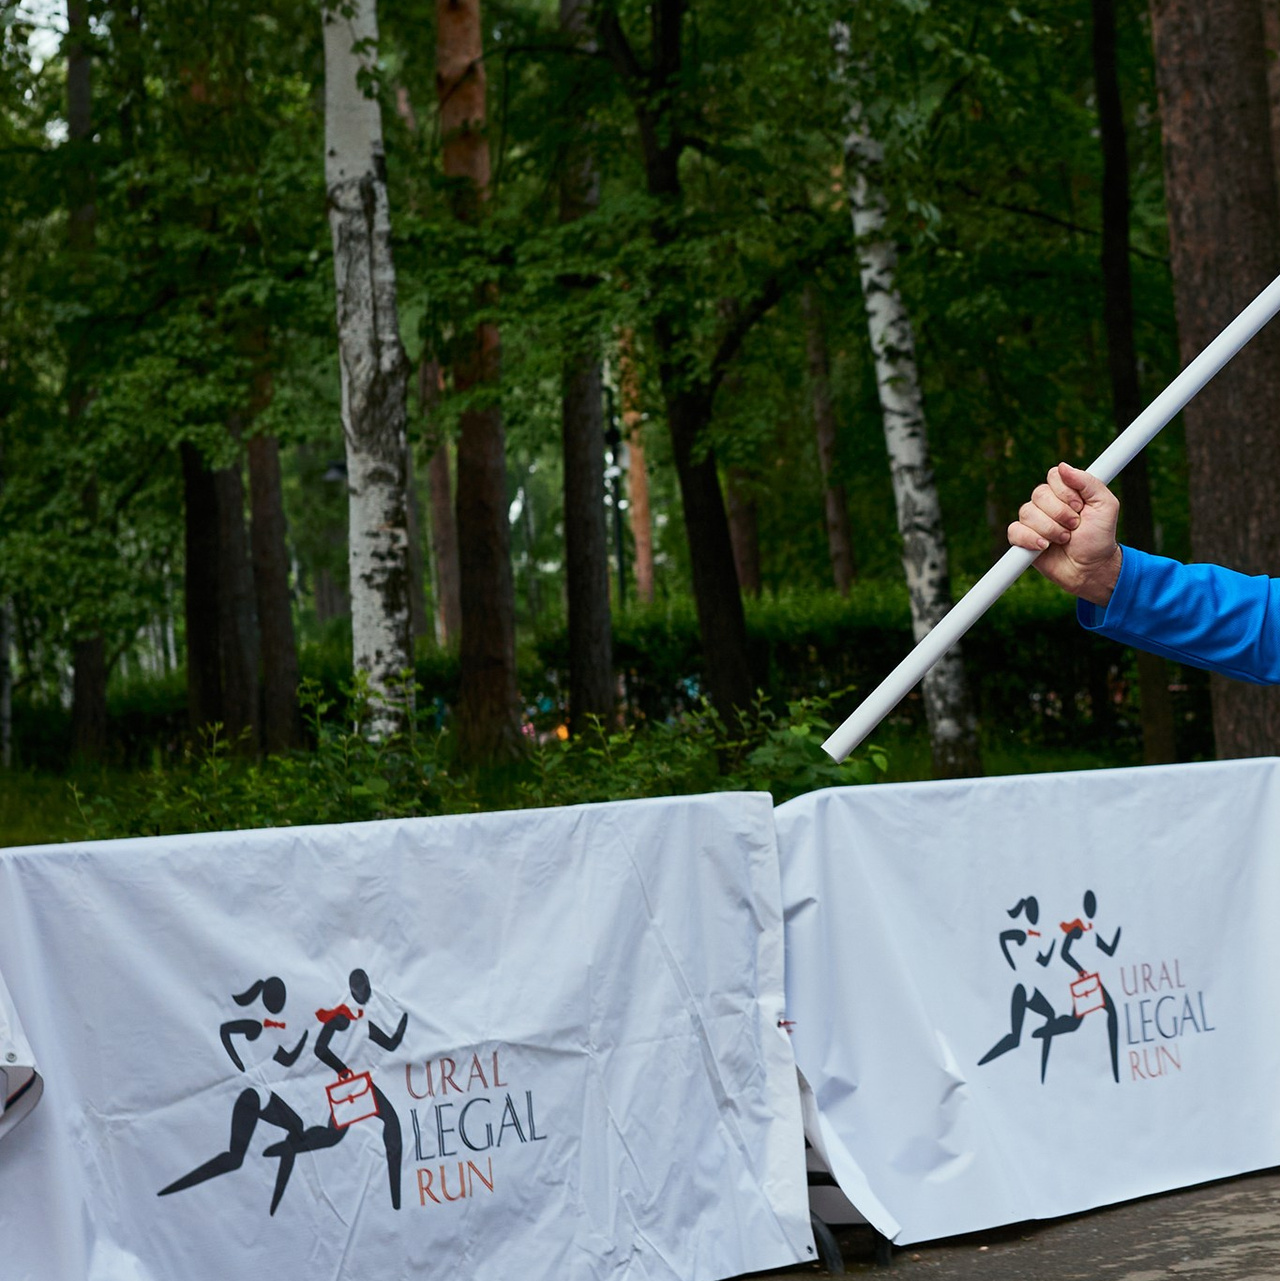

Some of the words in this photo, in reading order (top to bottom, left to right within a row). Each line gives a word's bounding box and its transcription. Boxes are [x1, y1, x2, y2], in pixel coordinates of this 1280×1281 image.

[1120, 959, 1186, 996] URAL
[1124, 990, 1216, 1045] LEGAL
[405, 1051, 508, 1099] URAL
[1129, 1043, 1181, 1081] RUN
[410, 1090, 548, 1161] LEGAL
[416, 1157, 494, 1206] RUN
